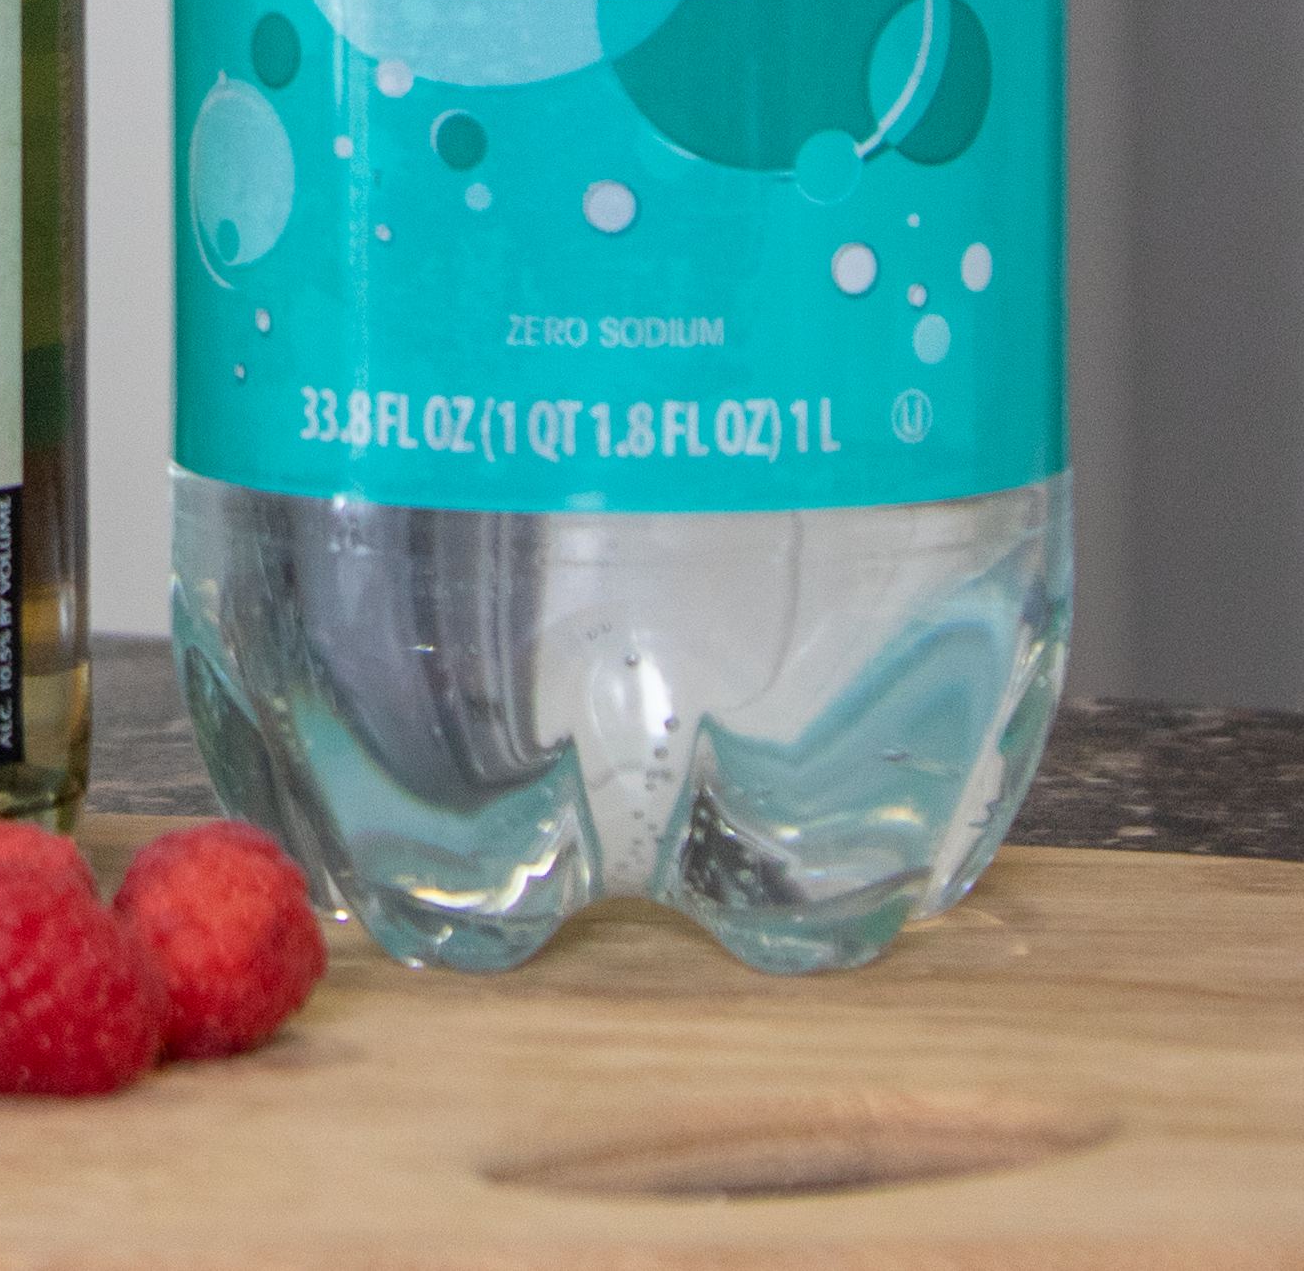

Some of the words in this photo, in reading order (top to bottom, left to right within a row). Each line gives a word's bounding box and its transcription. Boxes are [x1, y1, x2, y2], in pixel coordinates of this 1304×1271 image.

[504, 312, 589, 350] ZERO
[597, 313, 726, 350] SODIUM
[526, 397, 584, 464] QT
